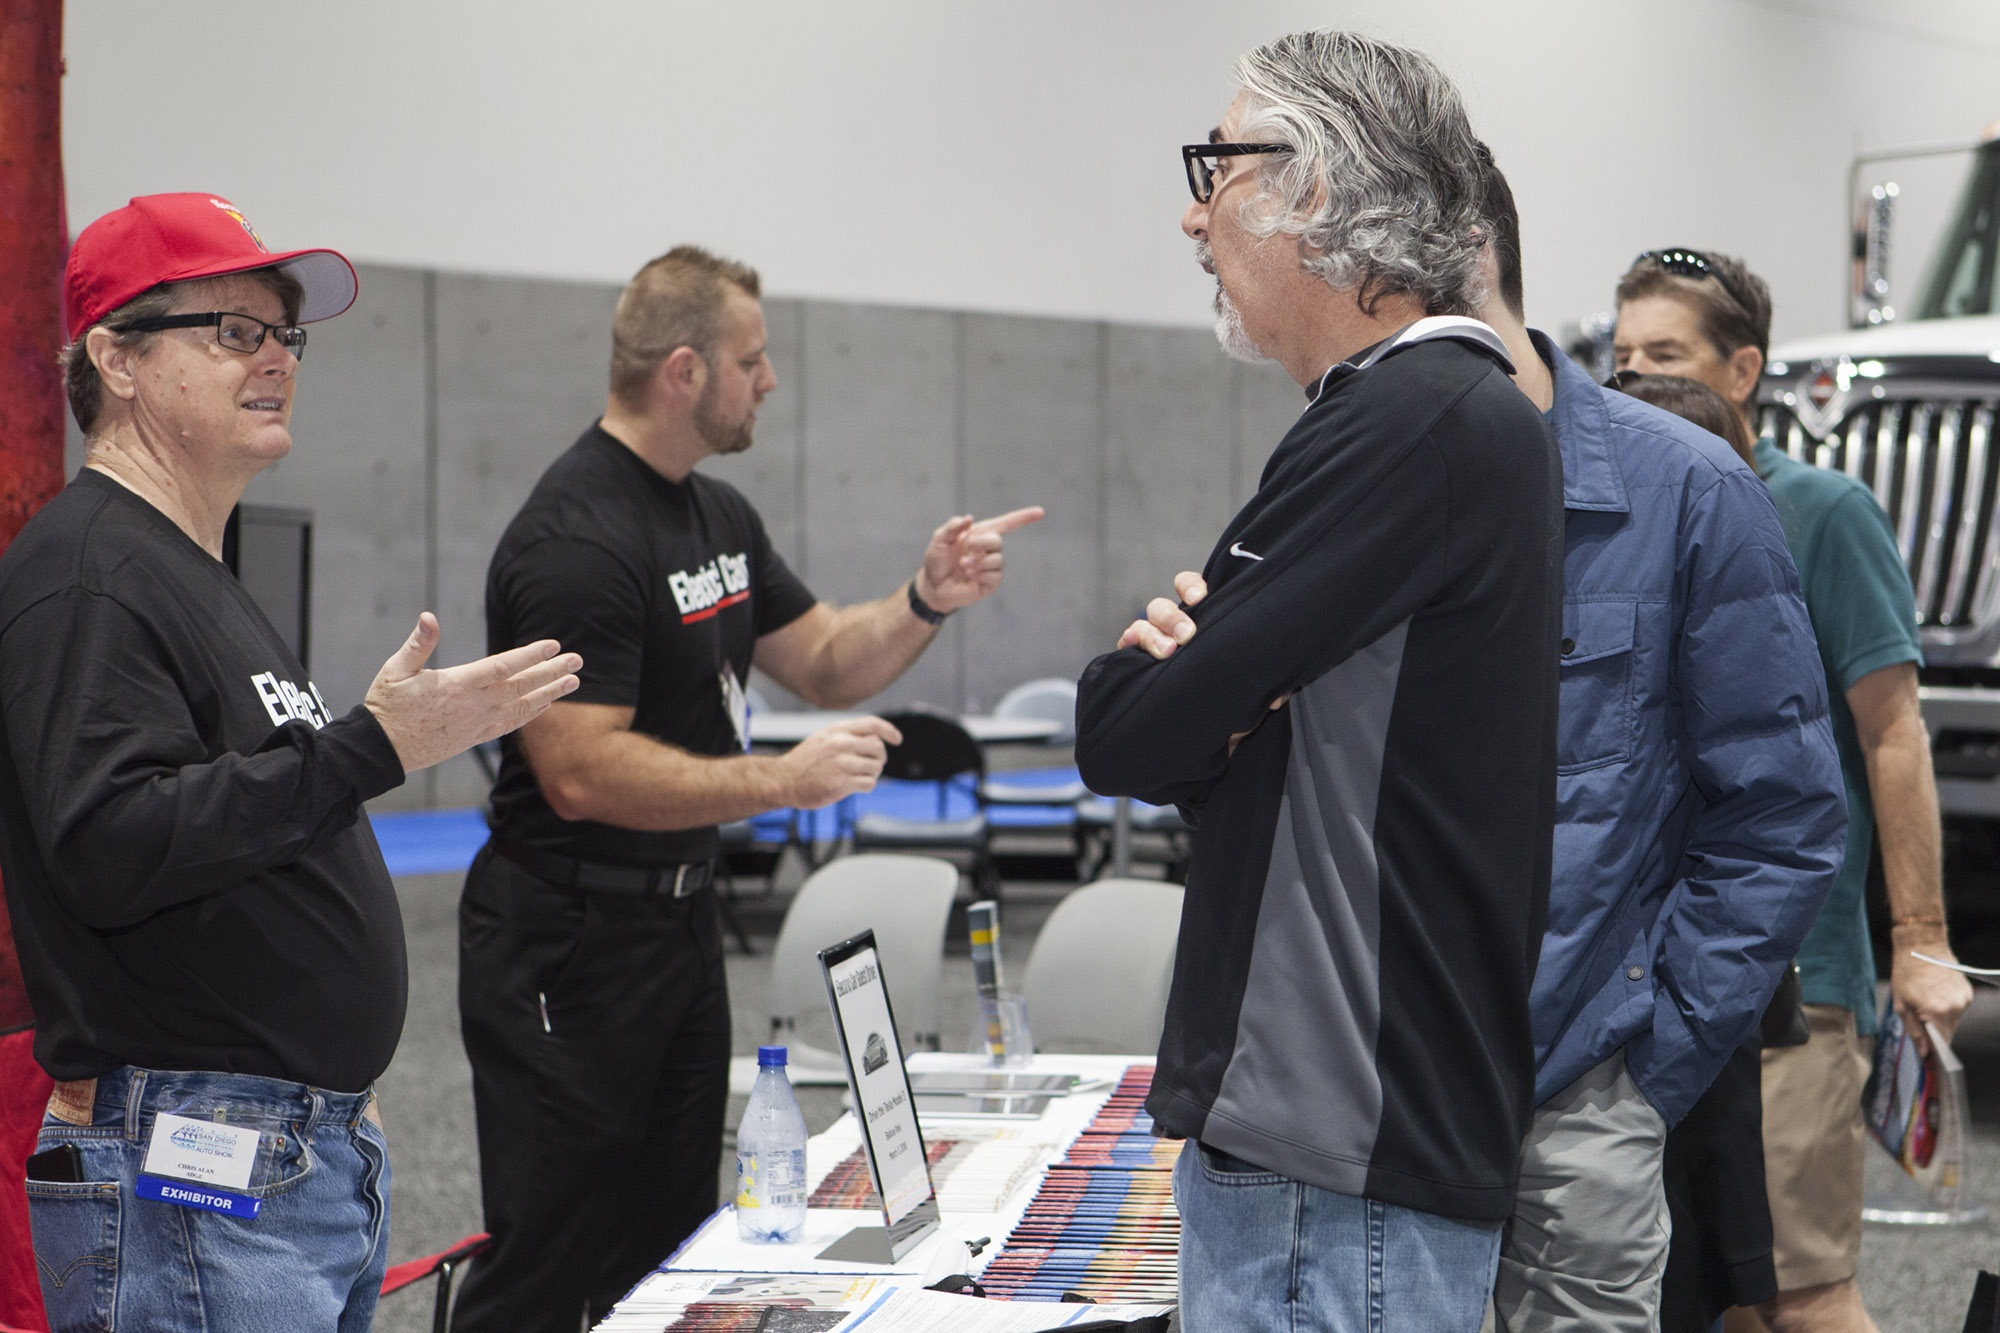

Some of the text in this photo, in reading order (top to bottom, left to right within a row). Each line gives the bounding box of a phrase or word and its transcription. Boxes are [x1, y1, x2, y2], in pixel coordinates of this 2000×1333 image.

[198, 1132, 237, 1146] SAN DIEGO
[196, 1146, 234, 1160] AUTO SHOW
[178, 1163, 215, 1175] CHRIS ALAN
[161, 1187, 232, 1209] EXHIBITOR
